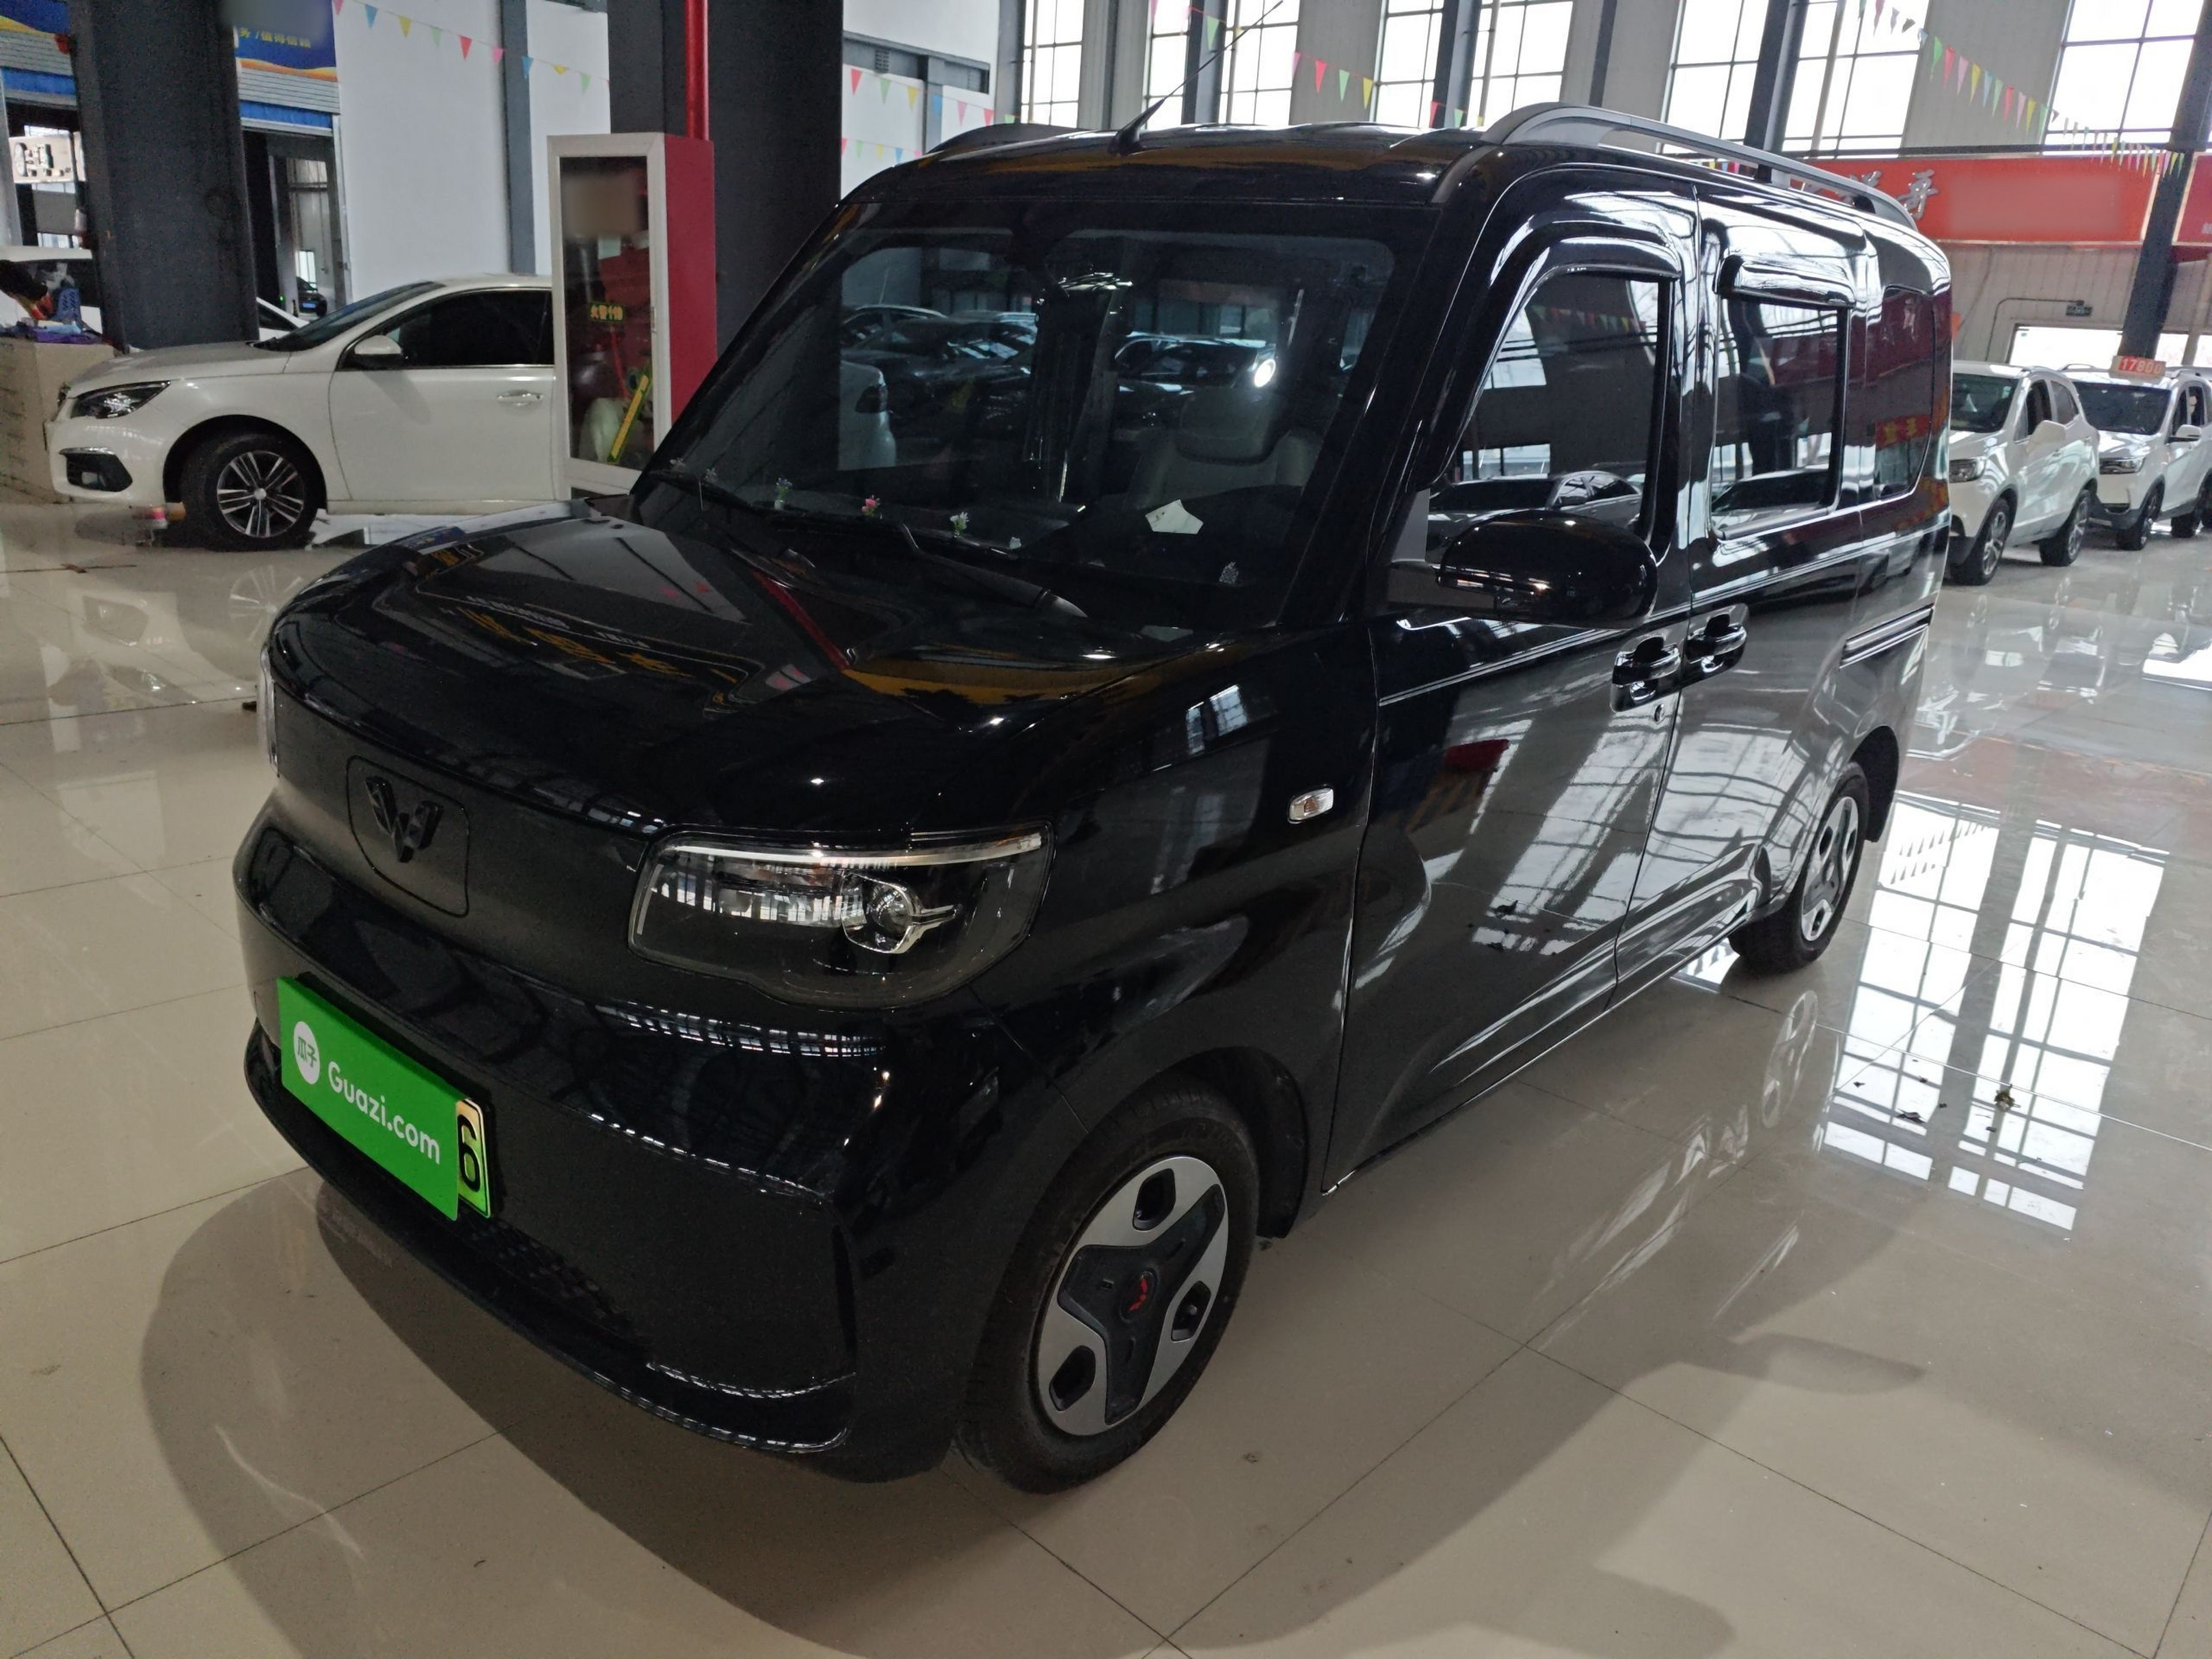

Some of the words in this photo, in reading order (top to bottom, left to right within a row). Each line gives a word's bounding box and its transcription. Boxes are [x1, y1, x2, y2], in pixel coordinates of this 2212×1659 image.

[297, 1036, 317, 1067] 瓜子
[328, 1061, 440, 1165] Guazi.com
[457, 1114, 481, 1192] 6
